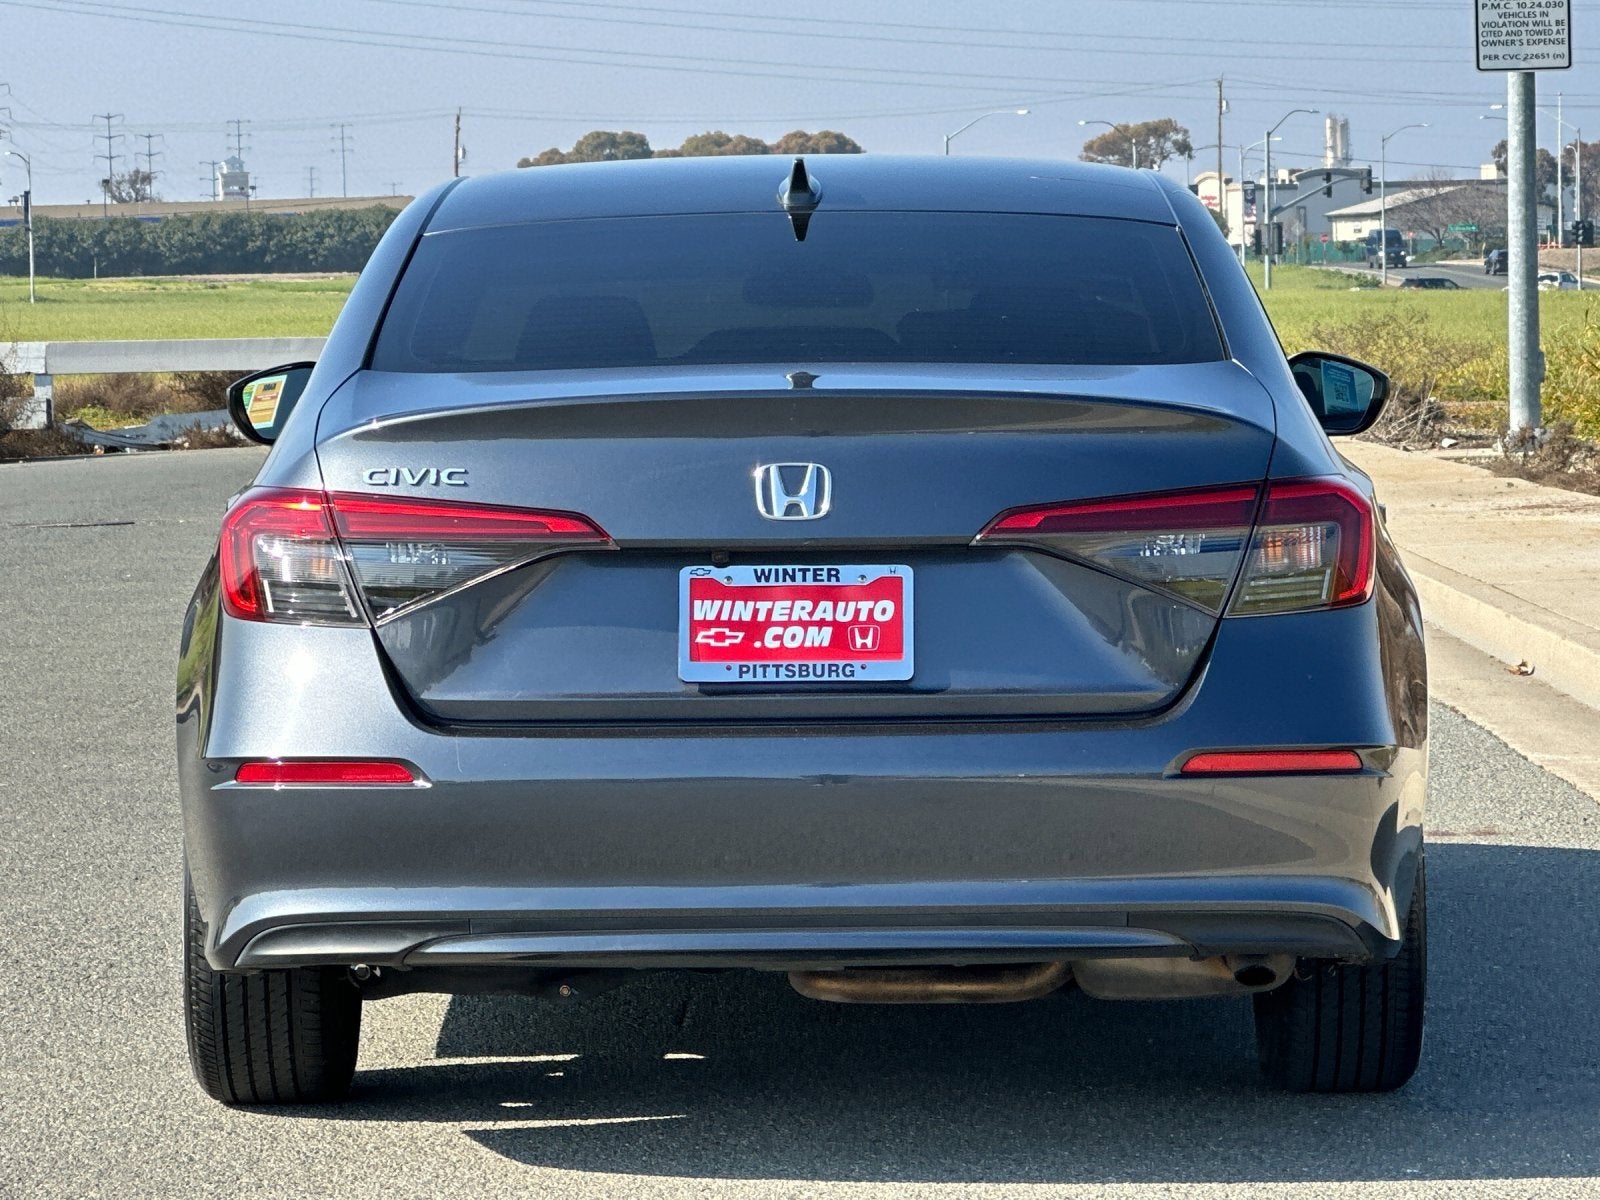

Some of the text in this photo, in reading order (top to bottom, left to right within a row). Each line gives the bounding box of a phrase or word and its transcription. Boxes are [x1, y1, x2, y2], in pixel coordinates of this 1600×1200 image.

[1481, 1, 1564, 10] P.M.C. 10.24.030
[1497, 10, 1549, 19] VEHICLES IN
[1481, 20, 1529, 28] VIOLATION
[1555, 19, 1566, 27] BE
[1481, 28, 1566, 38] CITED AND TOWED AT
[1481, 38, 1566, 47] OWNER'S EXPENSE
[1523, 53, 1550, 61] 22651
[362, 467, 468, 486] CIVIC
[752, 567, 841, 583] WINTER
[693, 599, 895, 622] WINTERAUTO
[753, 626, 833, 648] .COM
[738, 663, 856, 678] PITTSBURG
